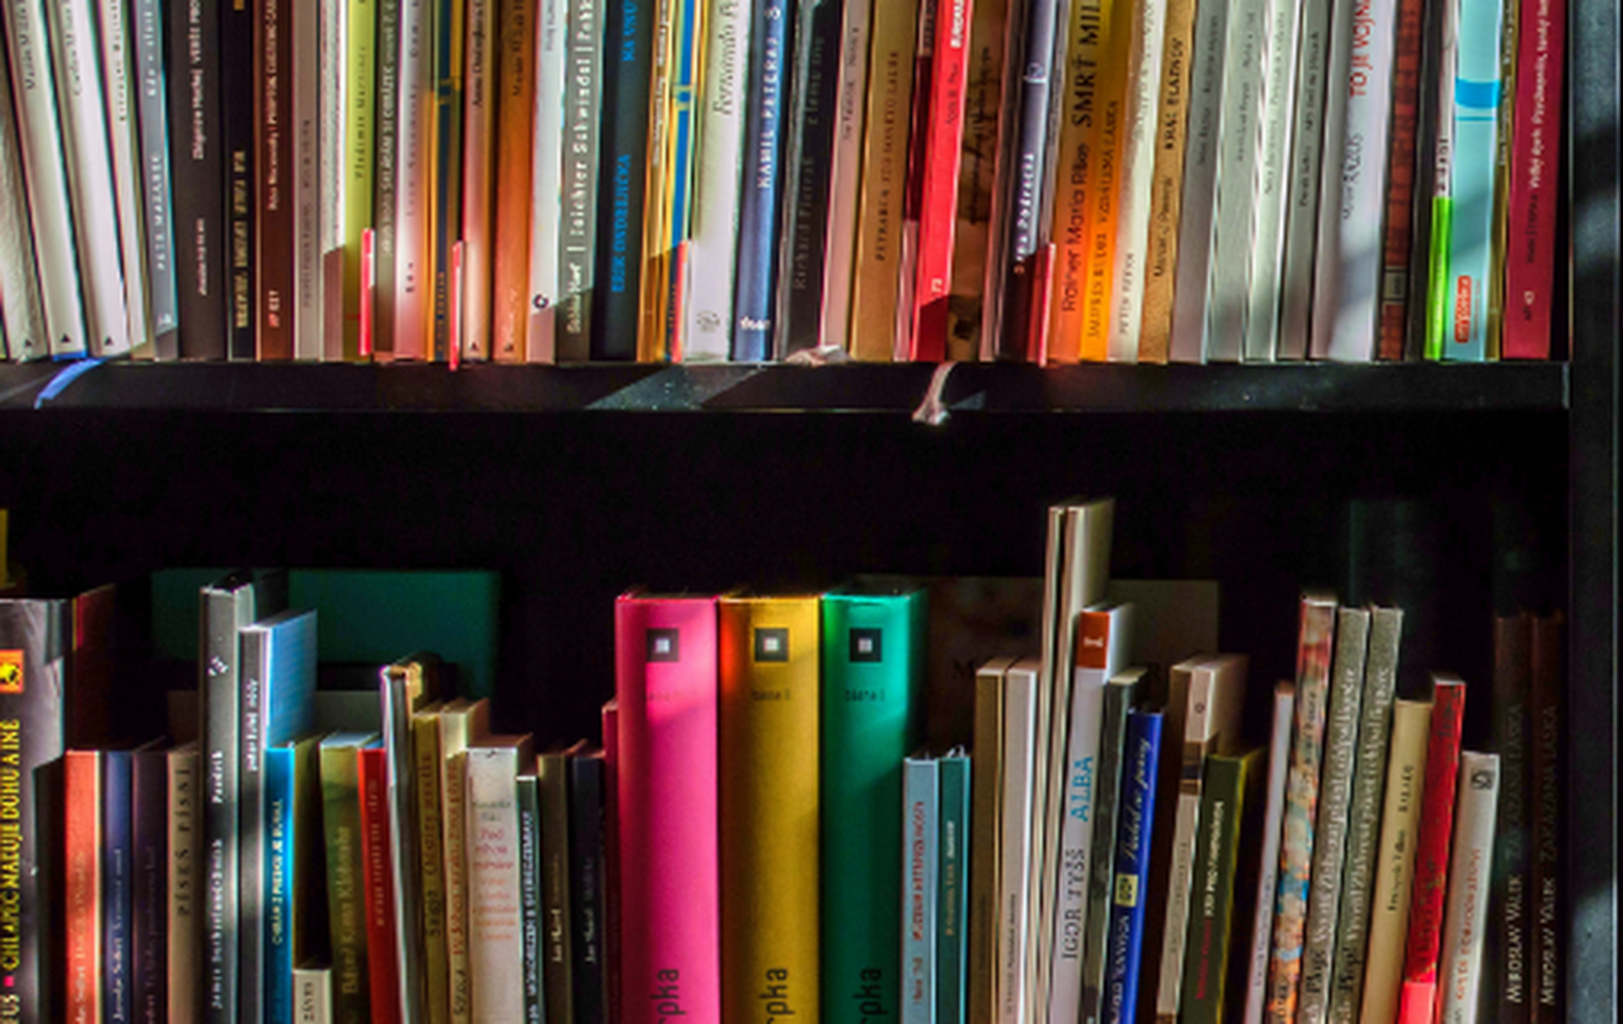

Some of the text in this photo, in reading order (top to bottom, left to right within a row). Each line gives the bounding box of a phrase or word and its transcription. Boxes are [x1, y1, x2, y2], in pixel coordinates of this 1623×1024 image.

[1066, 188, 1085, 246] Maria
[611, 255, 627, 293] ERIK
[1061, 249, 1080, 312] Rainer
[1069, 755, 1094, 823] ALBA
[1061, 908, 1082, 960] IGOR
